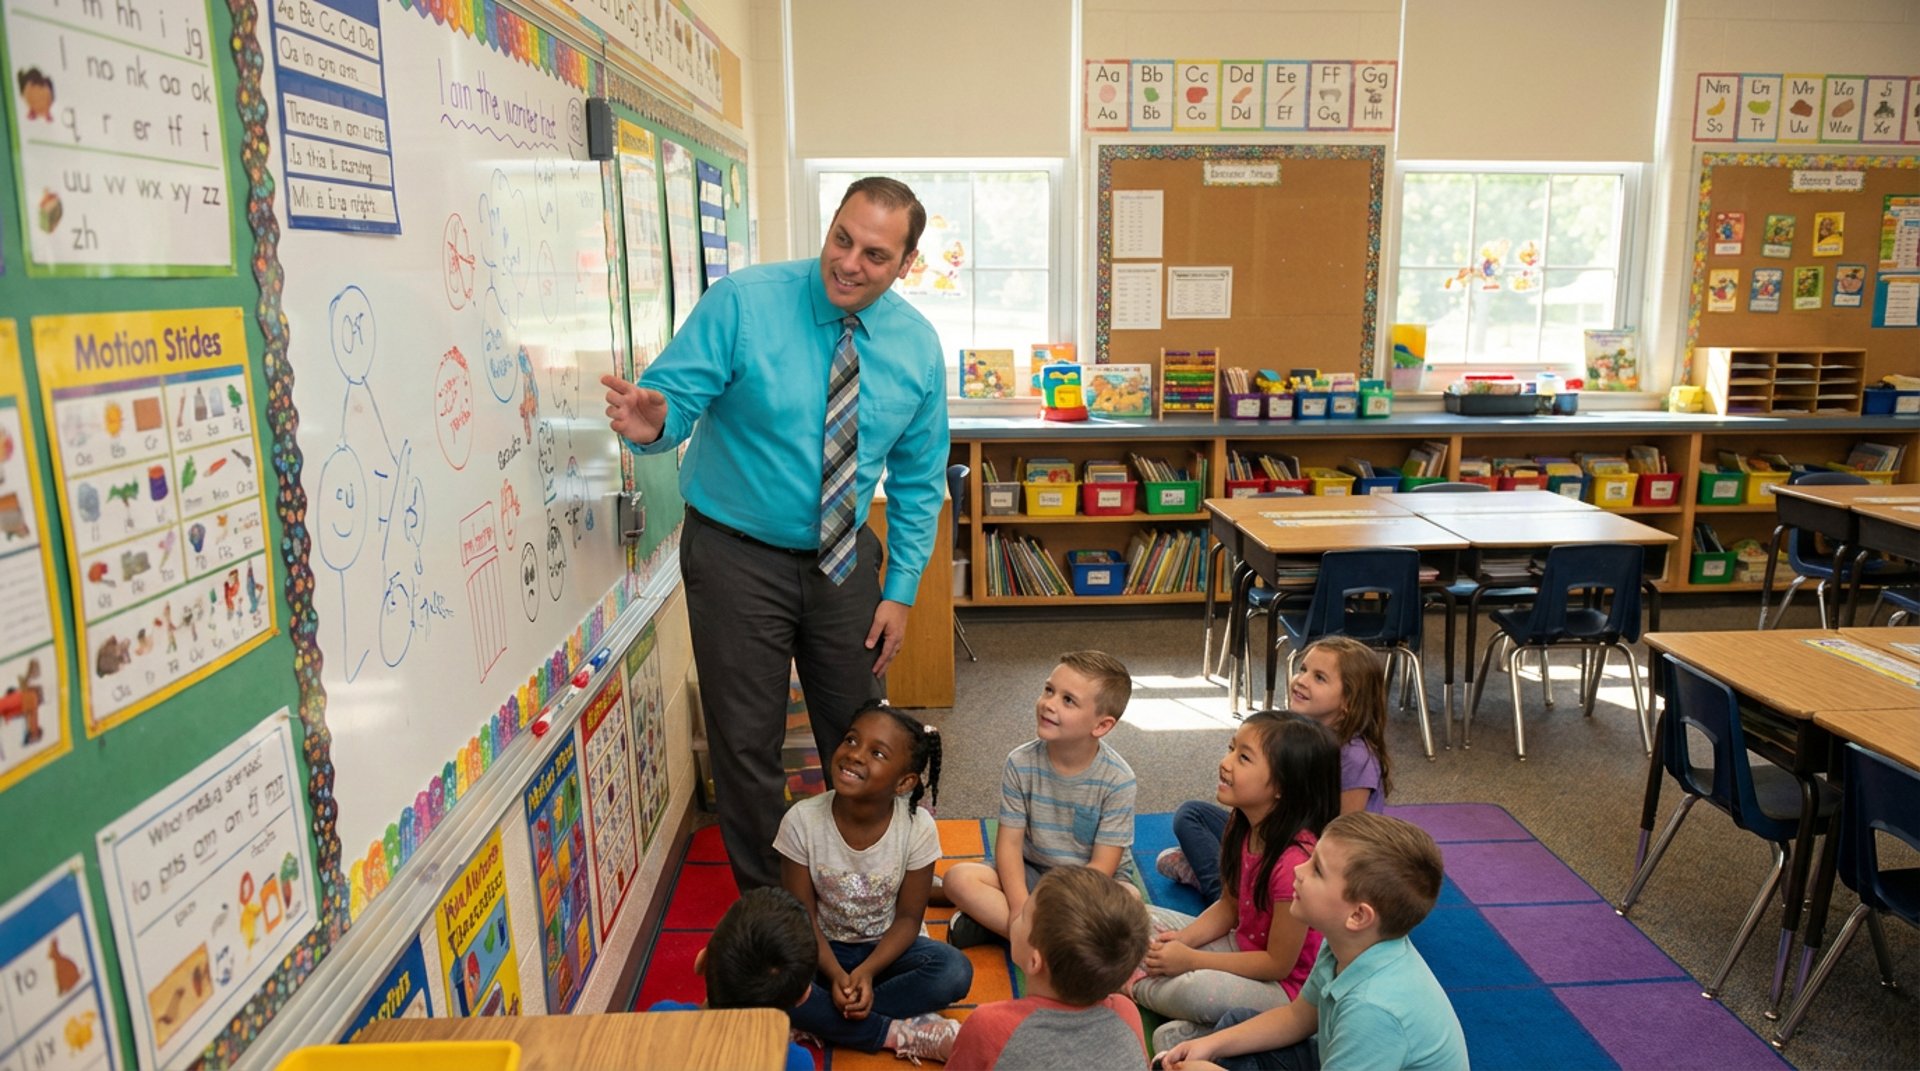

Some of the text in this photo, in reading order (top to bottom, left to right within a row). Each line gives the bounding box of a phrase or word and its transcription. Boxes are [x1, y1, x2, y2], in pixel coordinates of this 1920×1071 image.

[476, 69, 501, 121] the
[1096, 65, 1388, 89] Aa Bb Cc Dd Ee Ff Gg
[1098, 106, 1118, 121] Aa
[1143, 105, 1161, 121] Bb
[1231, 105, 1251, 121] Dd
[62, 170, 93, 195] uu
[202, 186, 221, 206] zz
[71, 214, 98, 251] zh
[74, 325, 222, 372] Motion Stides
